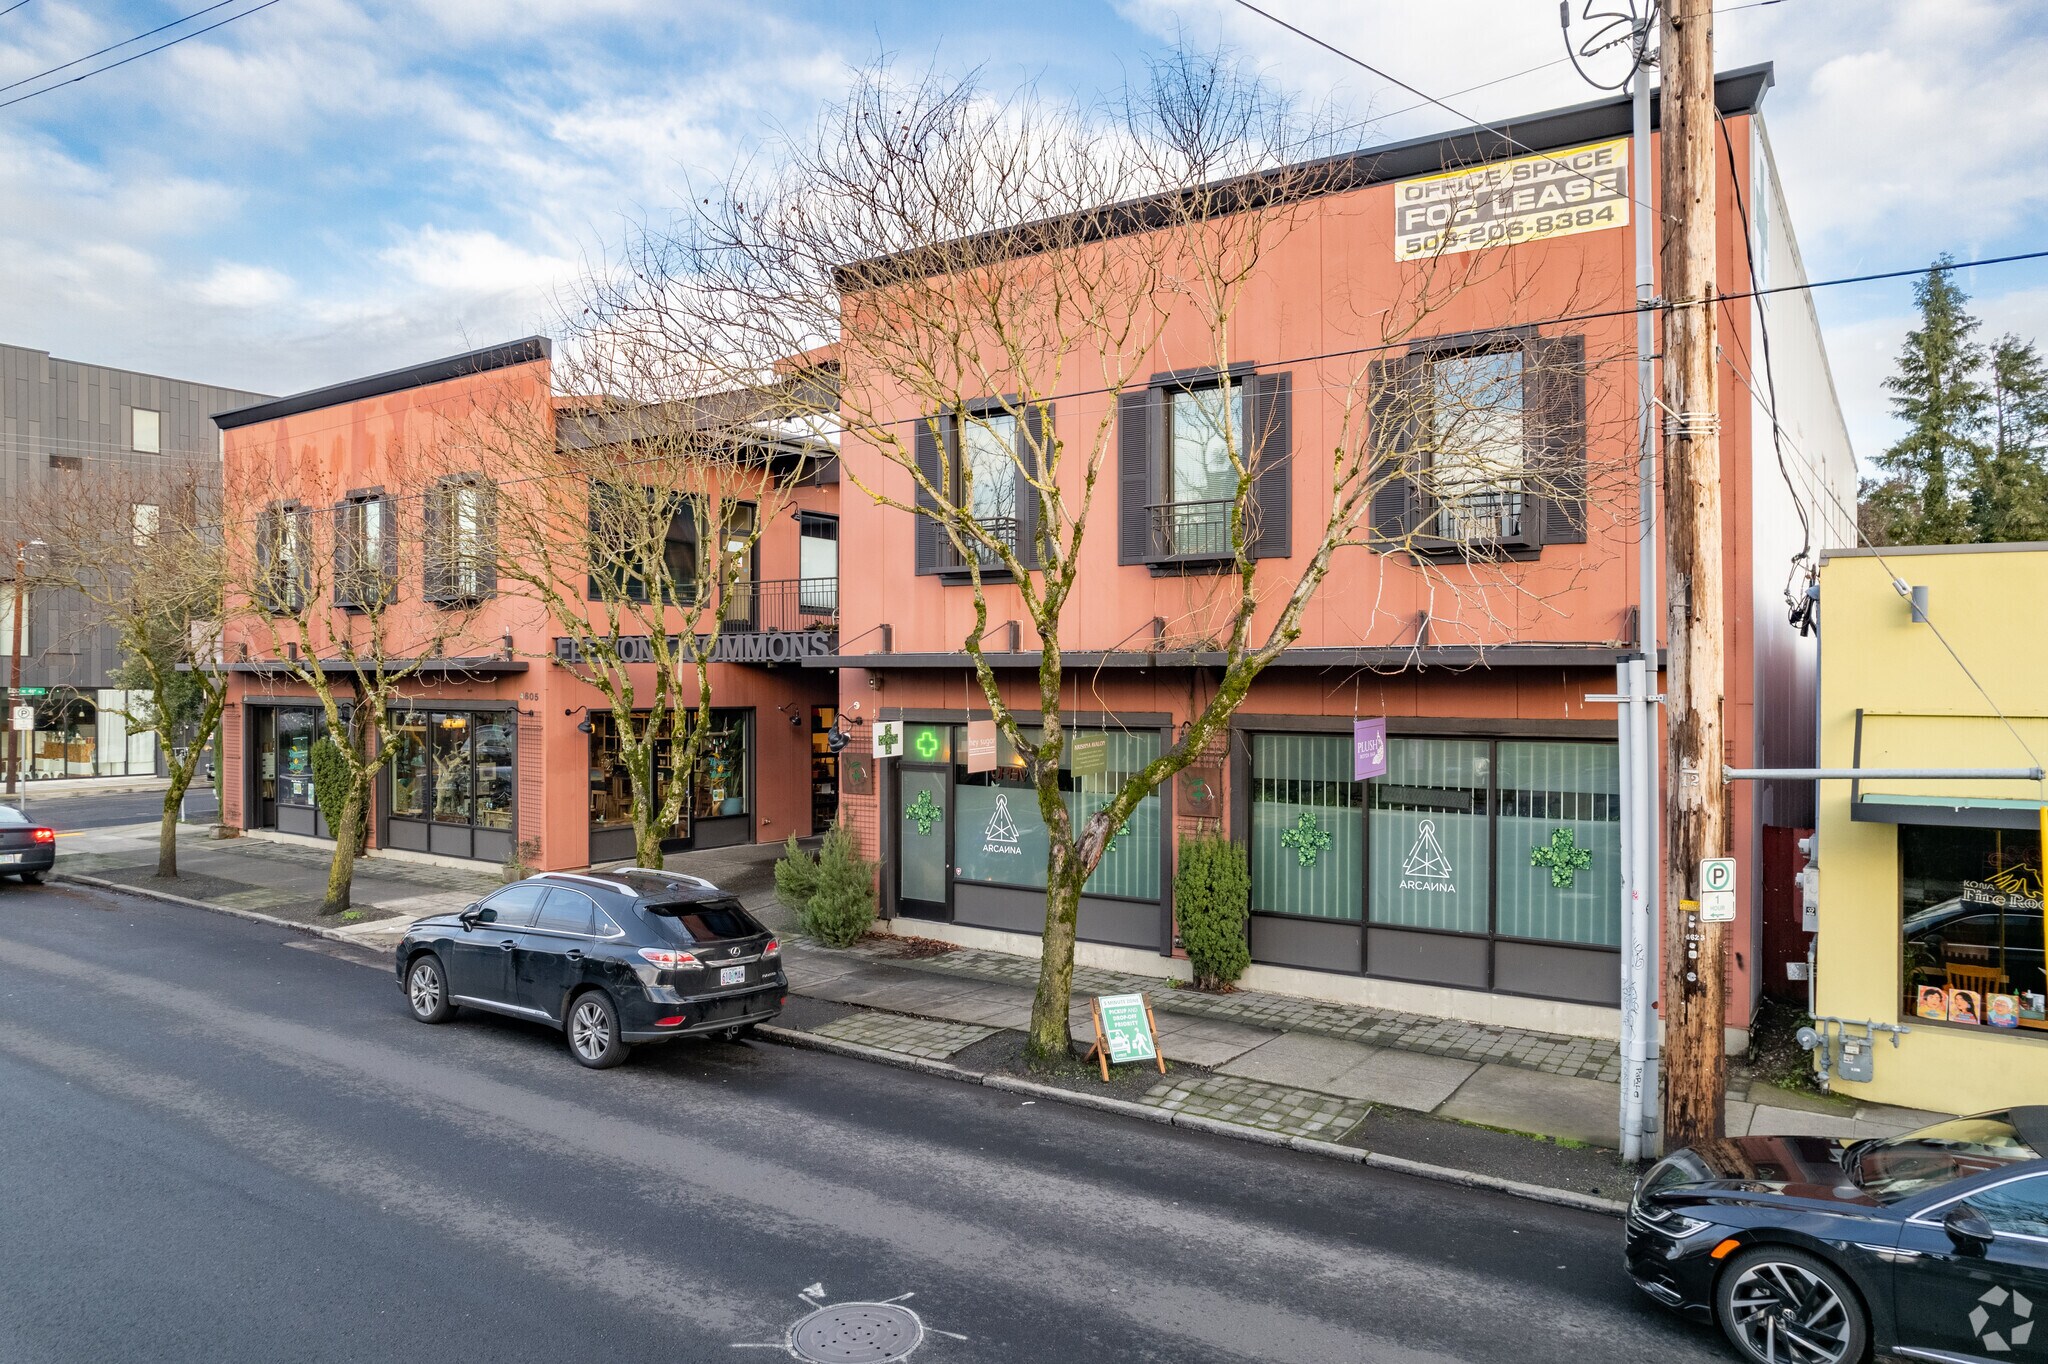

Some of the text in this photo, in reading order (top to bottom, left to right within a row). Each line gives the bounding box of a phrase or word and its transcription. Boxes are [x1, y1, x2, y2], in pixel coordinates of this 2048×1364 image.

[1405, 147, 1613, 201] OFFICE SPACE
[1405, 172, 1618, 231] FOR LEASE
[1405, 205, 1615, 254] 503-206-8384
[1357, 739, 1378, 753] PLUSH
[1713, 868, 1725, 885] P
[1963, 880, 1995, 891] KONA
[1962, 887, 2006, 906] Fire
